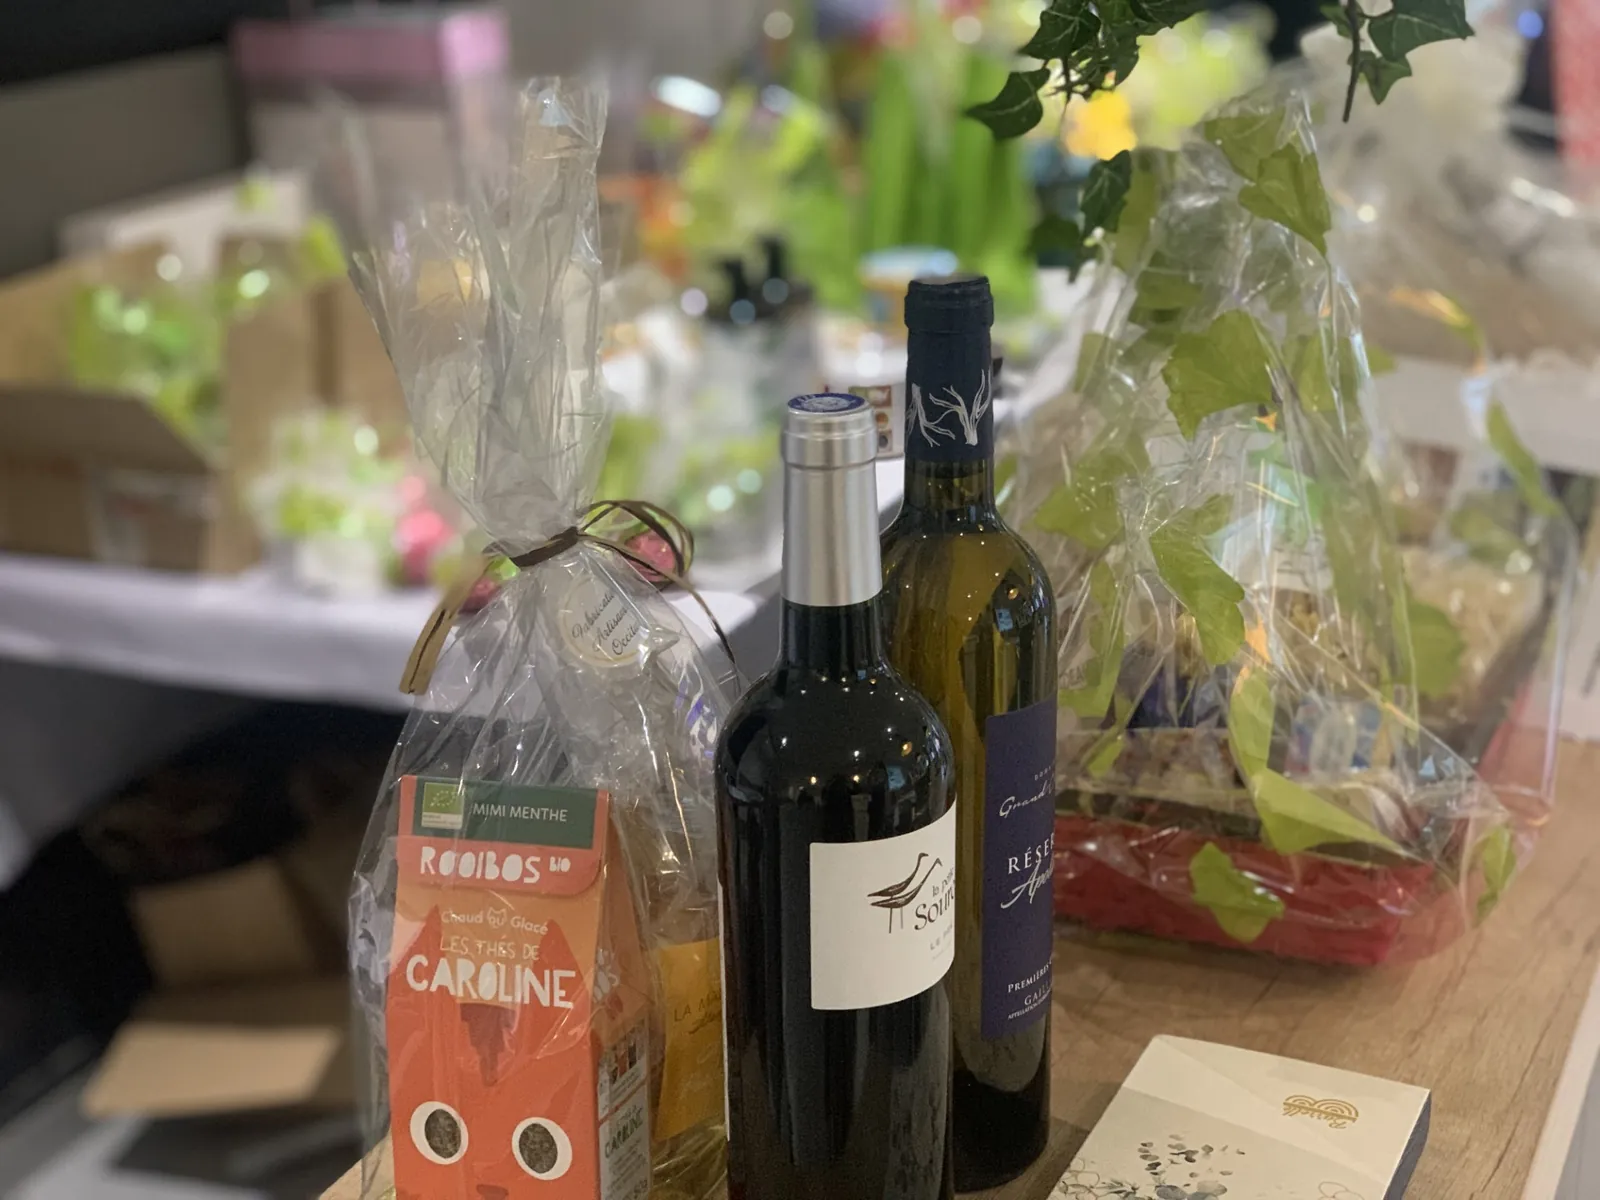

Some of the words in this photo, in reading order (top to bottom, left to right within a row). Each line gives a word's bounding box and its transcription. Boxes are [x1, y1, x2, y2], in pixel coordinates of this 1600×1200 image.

[473, 803, 506, 818] MIMI
[509, 806, 568, 822] MENTHE
[420, 846, 541, 883] ROOIBOS
[549, 856, 571, 872] BIO
[441, 909, 484, 925] Chaud
[510, 915, 549, 935] Glacé
[440, 936, 469, 955] LES
[476, 934, 516, 959] THÉS
[523, 944, 540, 961] DE
[406, 953, 576, 1009] CAROLINE
